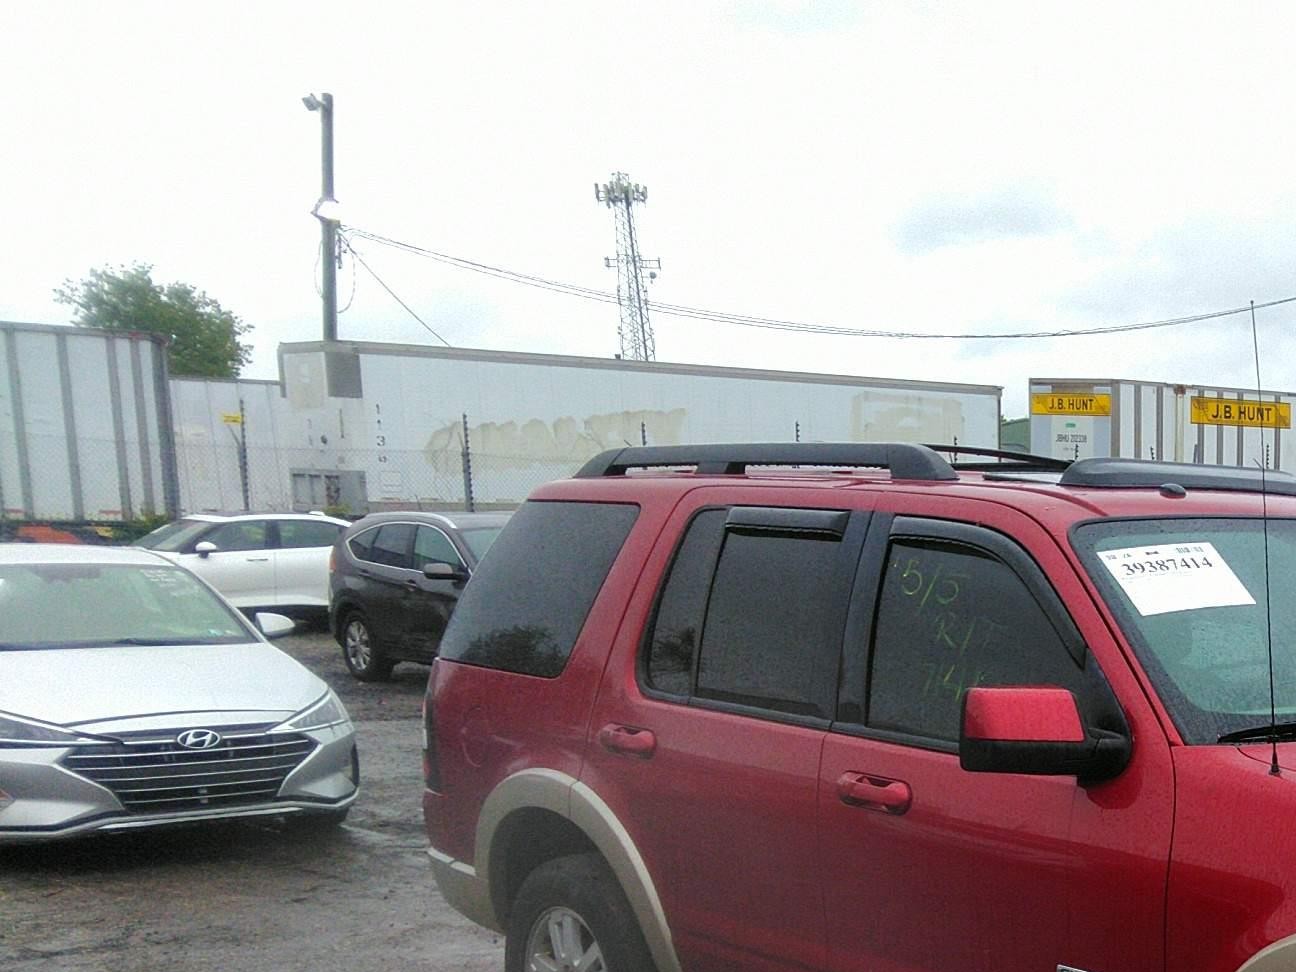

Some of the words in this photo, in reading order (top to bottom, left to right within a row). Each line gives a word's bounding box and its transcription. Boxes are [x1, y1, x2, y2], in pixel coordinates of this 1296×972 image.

[1048, 399, 1066, 411] J.B.
[1068, 399, 1095, 411] HUNT
[1211, 403, 1235, 420] J.B.
[1238, 405, 1272, 422] HUNT
[1120, 556, 1214, 576] 39387414
